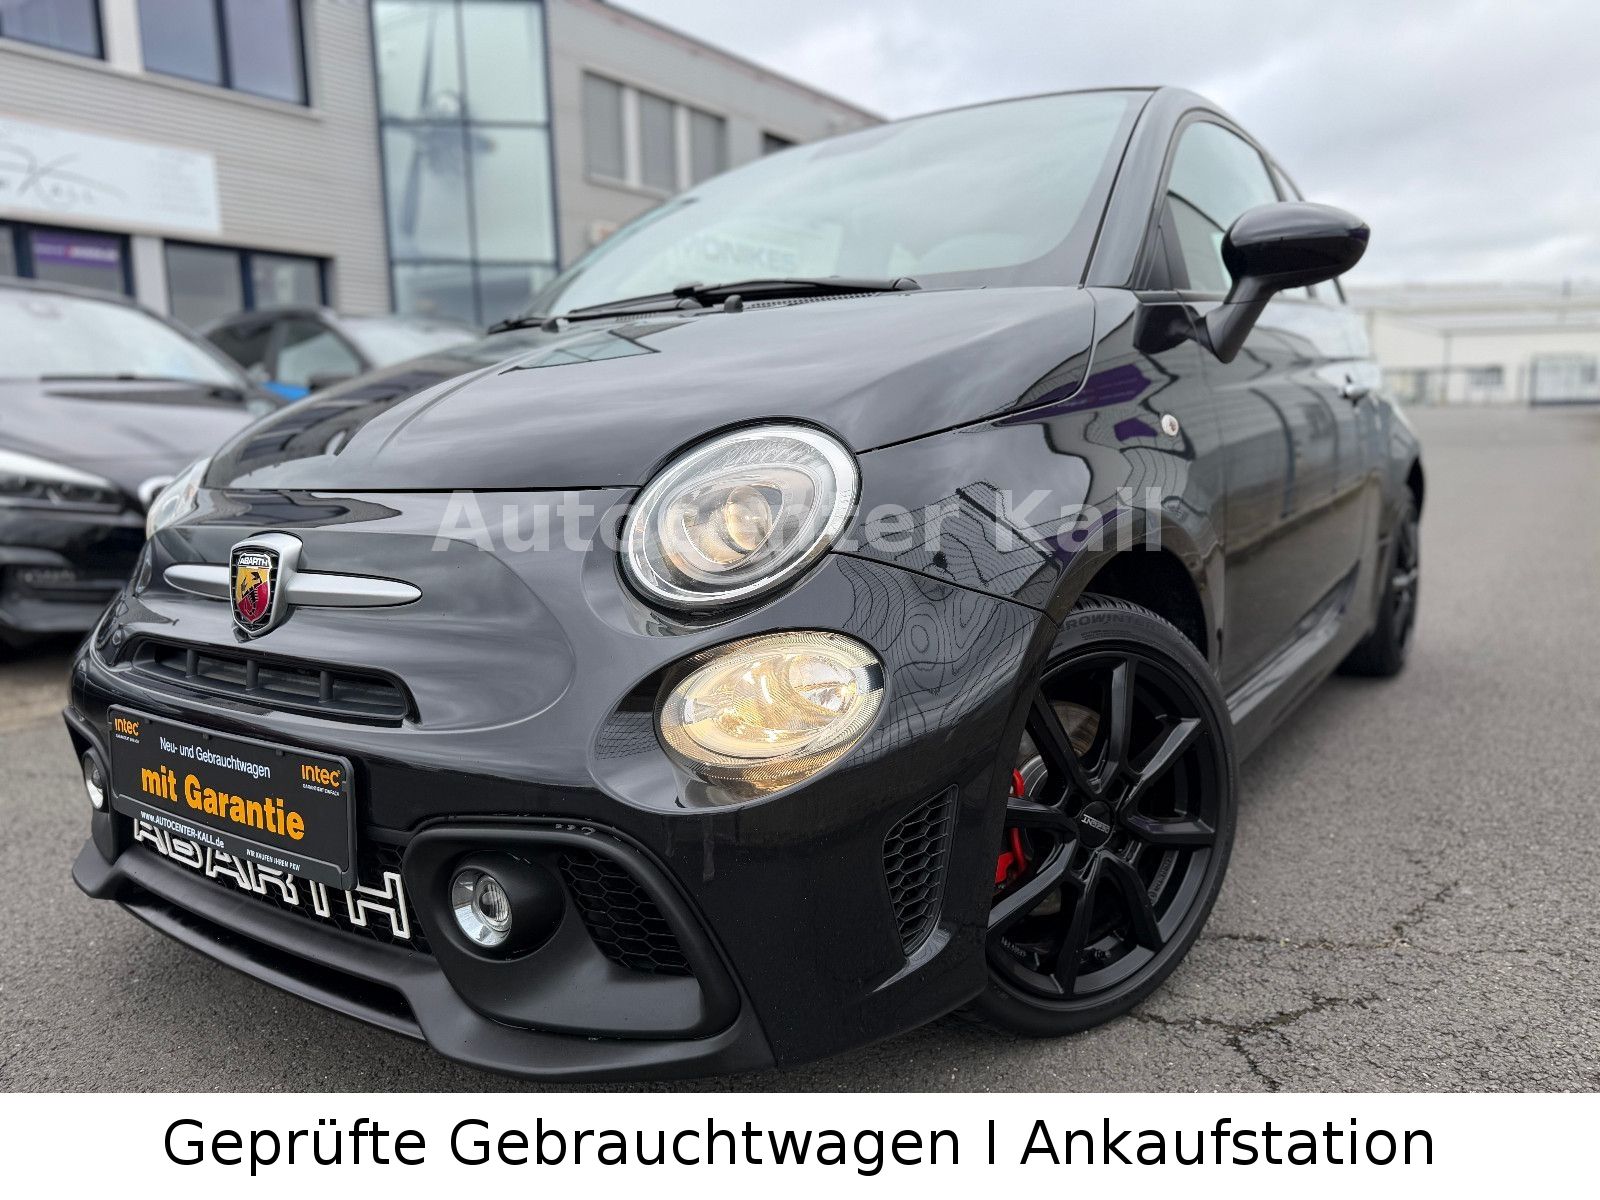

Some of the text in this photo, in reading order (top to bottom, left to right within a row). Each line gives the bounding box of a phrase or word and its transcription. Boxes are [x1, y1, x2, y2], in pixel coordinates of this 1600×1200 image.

[240, 556, 268, 567] ABARTH
[159, 737, 178, 756] Neu-
[179, 743, 194, 760] und
[196, 747, 271, 779] Gebrauchtwagen
[301, 764, 340, 788] intec
[141, 765, 305, 841] mit Garantie
[140, 811, 225, 849] www.AUTOCENTER-KALL.de
